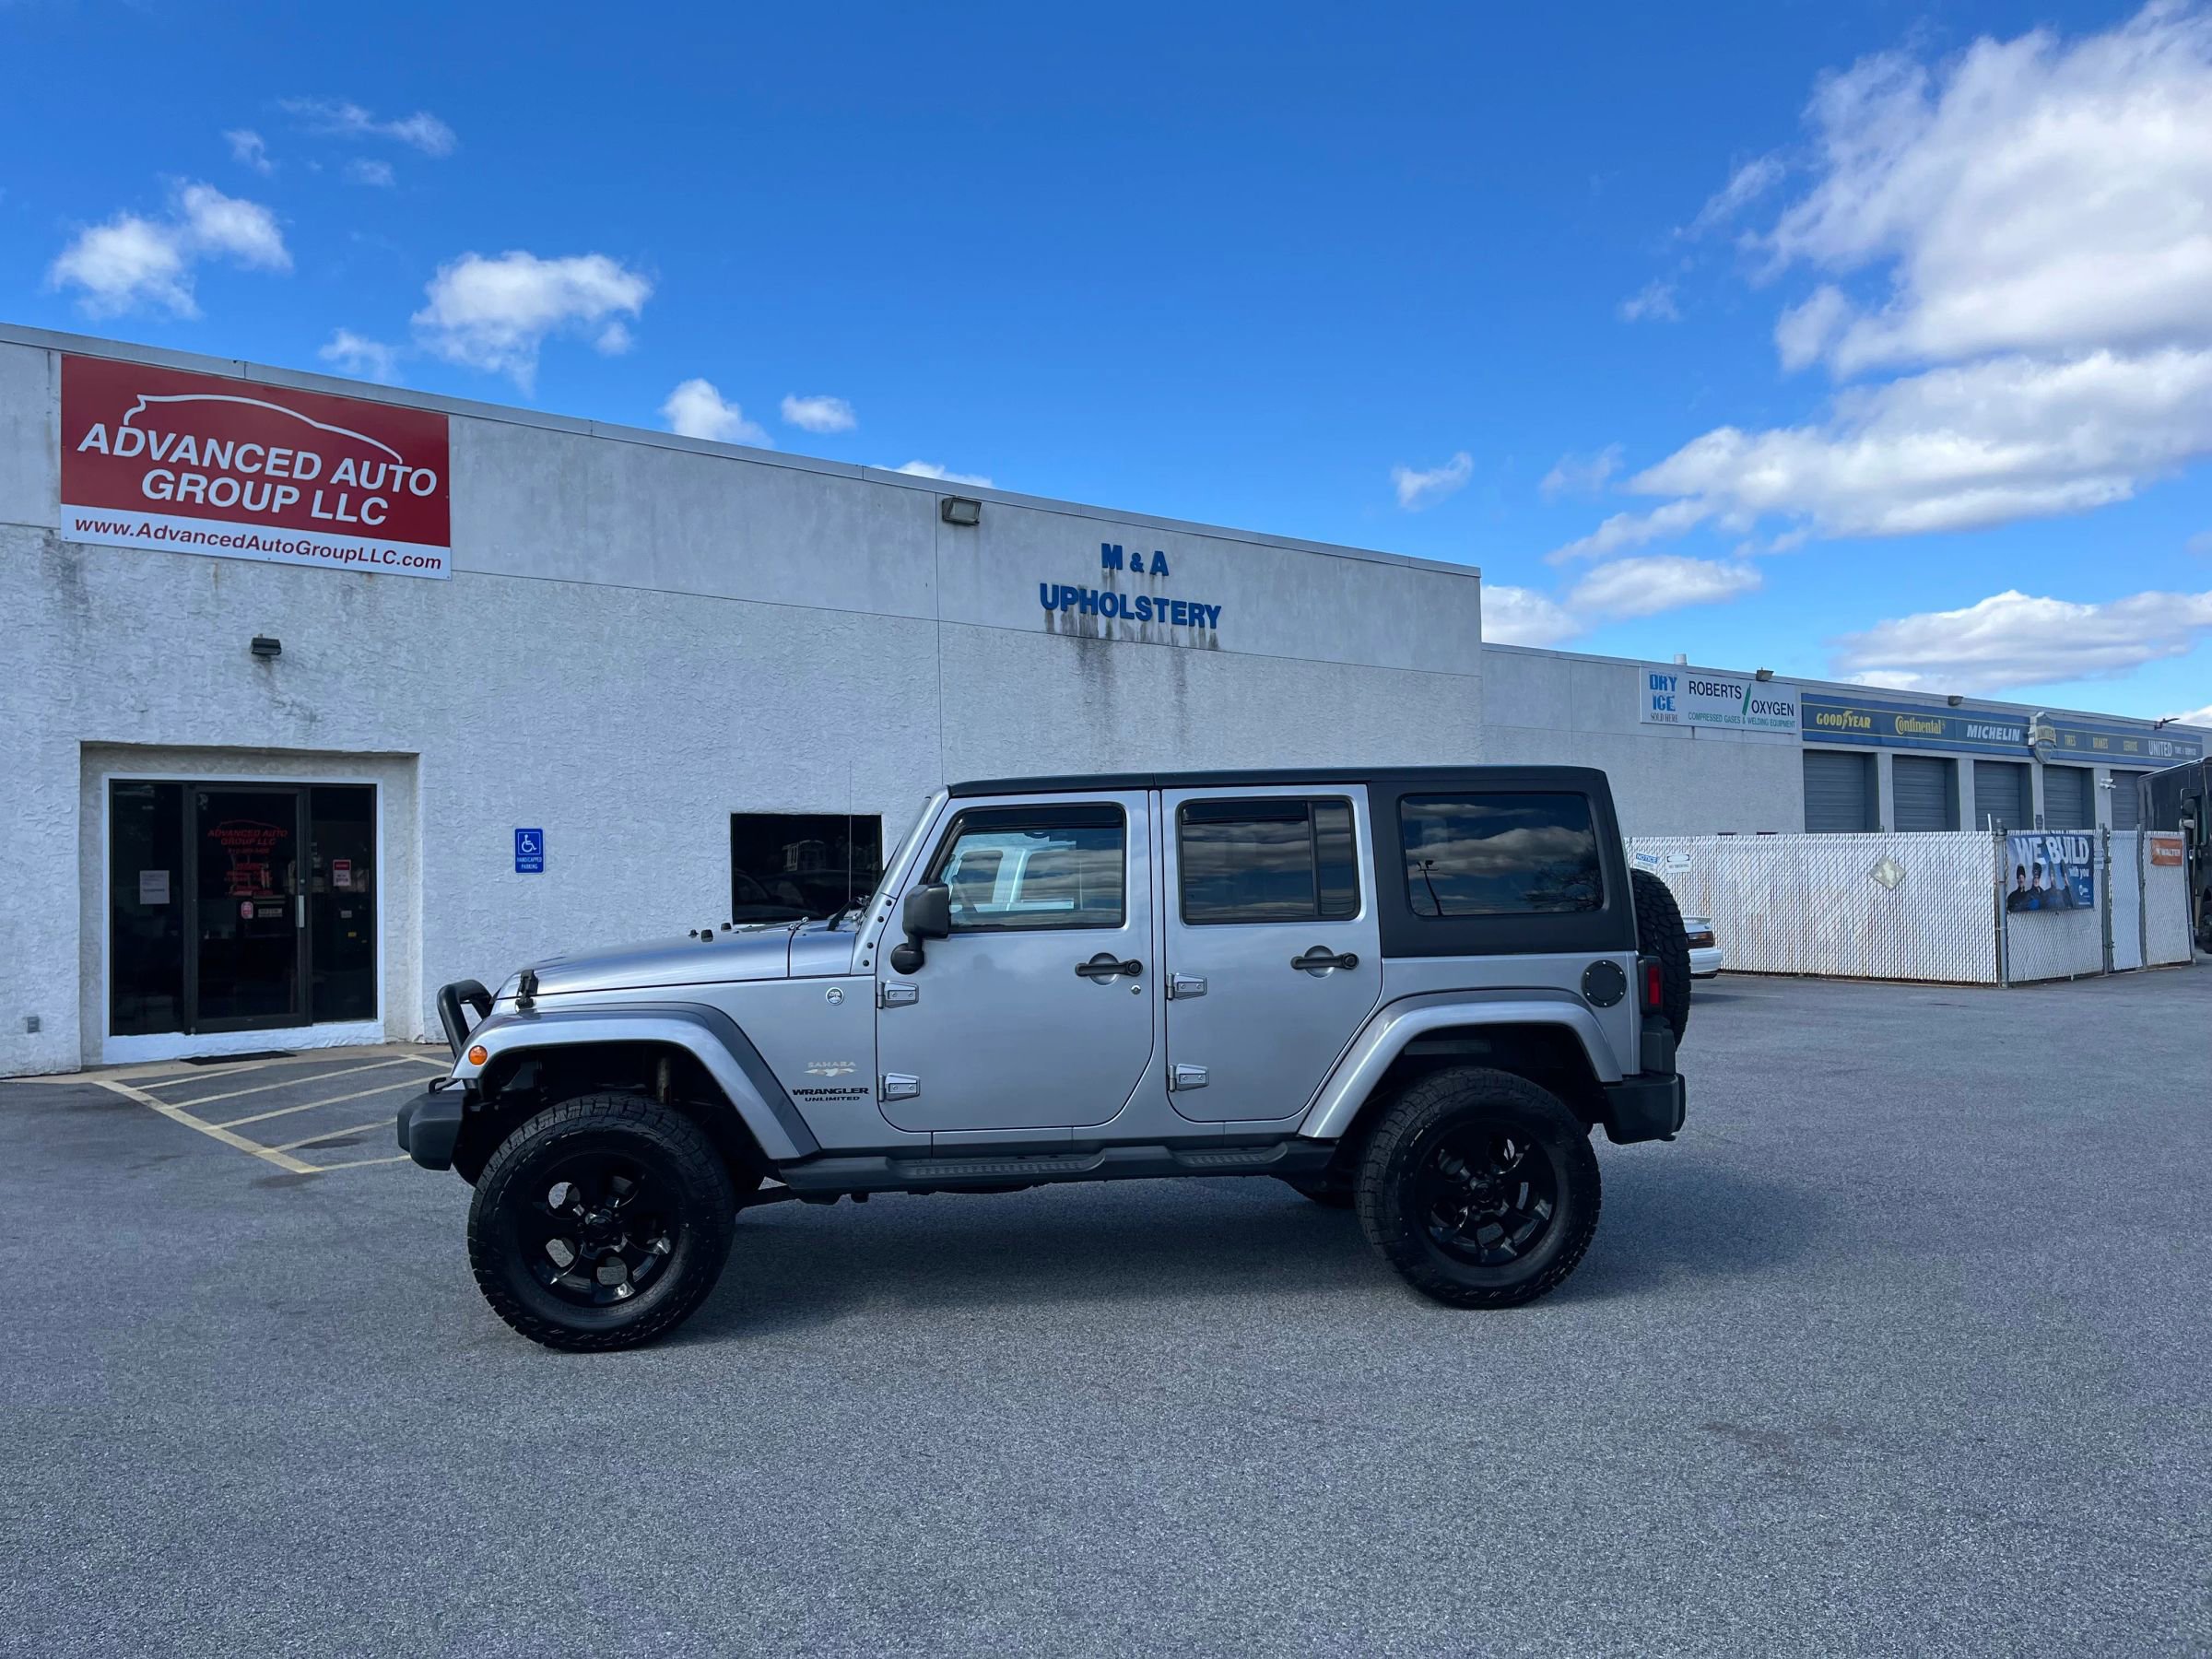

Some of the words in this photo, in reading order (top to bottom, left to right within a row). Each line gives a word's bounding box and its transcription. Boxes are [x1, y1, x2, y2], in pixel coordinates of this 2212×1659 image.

[77, 423, 322, 480] ADVANCED
[329, 458, 438, 497] AUTO
[141, 469, 300, 513] GROUP
[311, 488, 389, 525] LLC
[74, 518, 442, 570] www.AdvancedAutoGroupLLC.com
[1101, 543, 1123, 570] M
[1129, 552, 1144, 573] &
[1149, 550, 1170, 576] A
[1040, 582, 1222, 629] UPHOLSTERY
[1649, 674, 1677, 691] DRY
[1688, 680, 1742, 700] ROBERTS
[1653, 695, 1676, 712] ICE
[1751, 700, 1794, 716] OXYGEN
[1688, 712, 1723, 723] COMPRESSED
[1724, 714, 1741, 724] GASES
[1747, 717, 1769, 726] WELDING
[1770, 718, 1795, 728] EQUIPMENT
[1816, 710, 1871, 730] GOODYEAR
[1895, 715, 1942, 735] Continental
[1967, 724, 2020, 742] MICHELIN
[2147, 739, 2172, 758] UNITED
[207, 828, 261, 838] ADVANCED
[262, 829, 288, 838] AUTO
[220, 837, 255, 846] GROUP
[257, 837, 276, 846] LLC
[1636, 853, 1657, 864] NOTICE
[2016, 838, 2046, 865] WE
[2045, 836, 2089, 865] BUILD
[792, 1088, 869, 1096] WRANGLER
